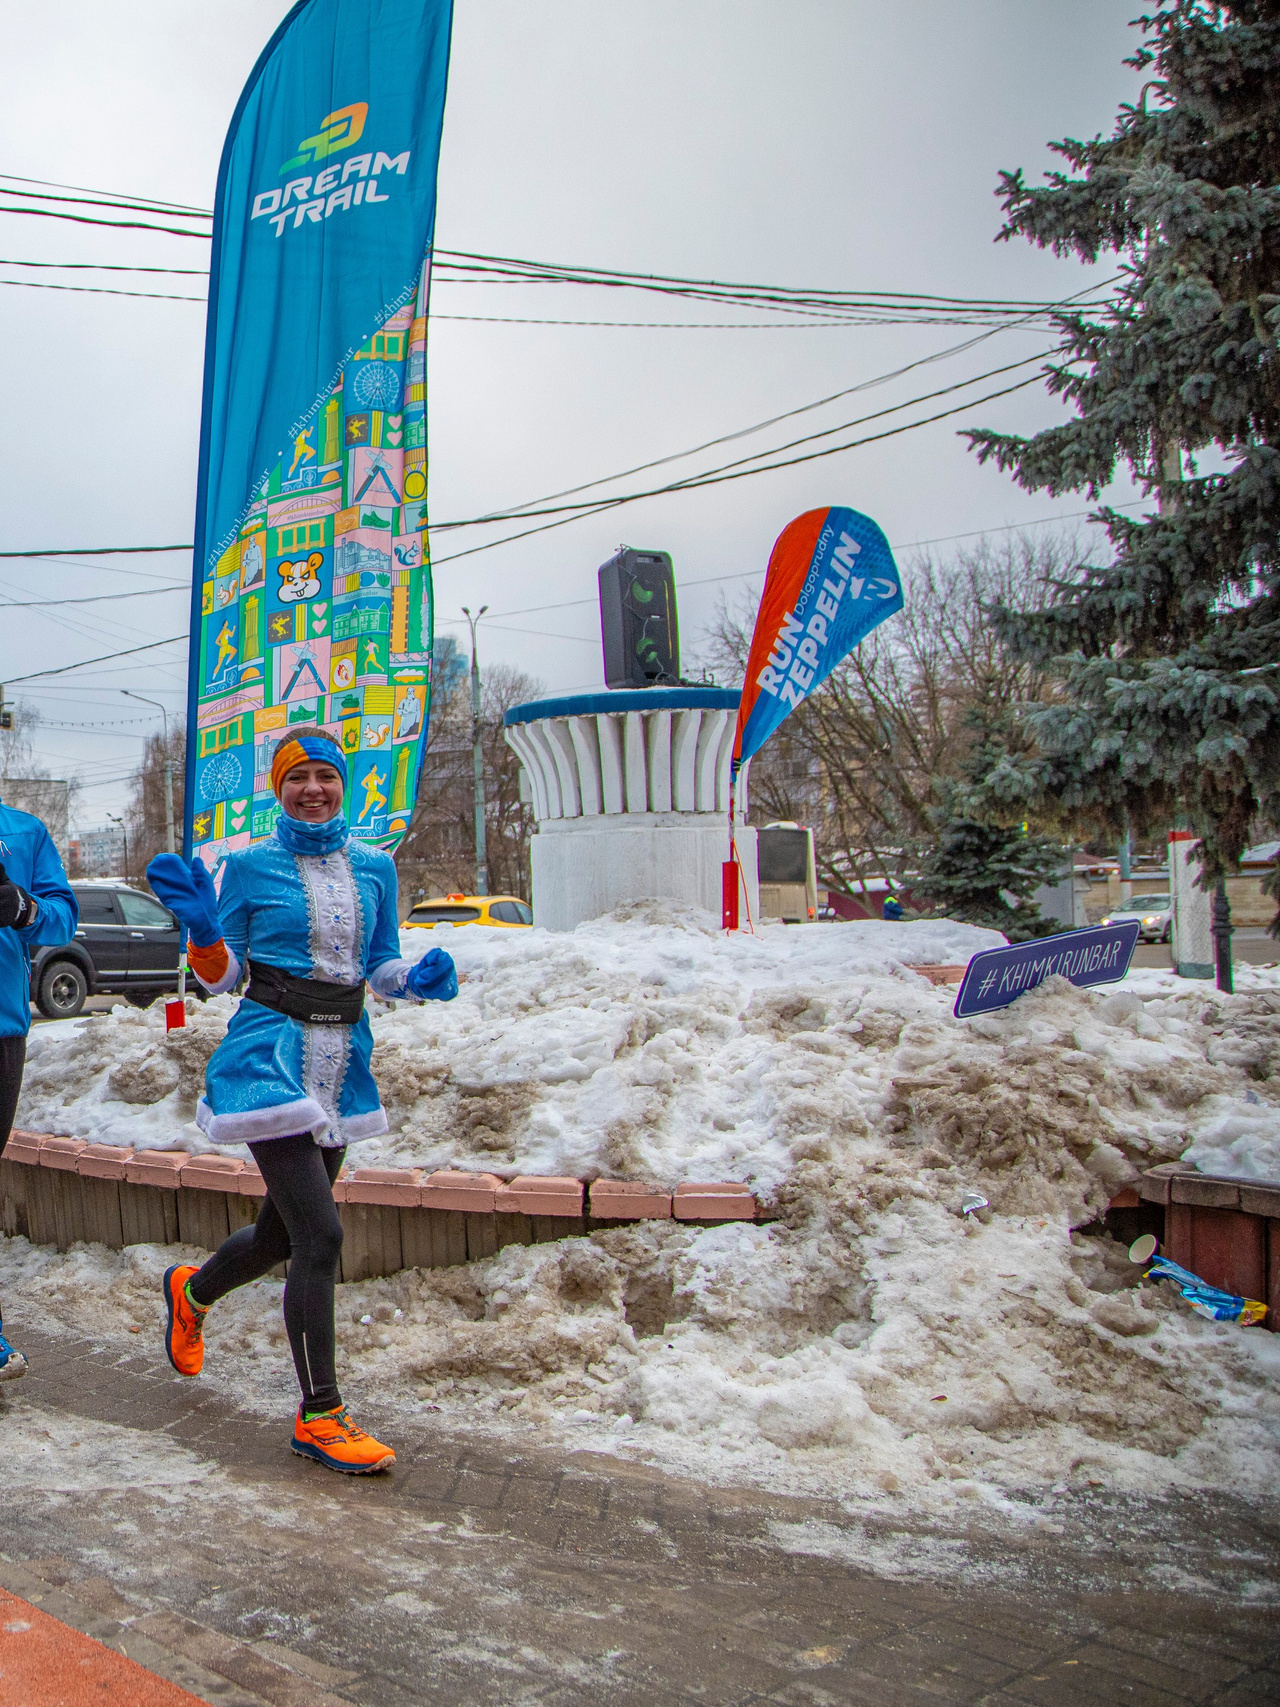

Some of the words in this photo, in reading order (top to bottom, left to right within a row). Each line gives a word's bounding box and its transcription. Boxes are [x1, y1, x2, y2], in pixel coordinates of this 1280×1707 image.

[251, 150, 411, 220] DREAM
[269, 179, 390, 238] TRAIL
[287, 346, 355, 439] #khimkirunbar
[756, 611, 805, 697] RUN
[794, 523, 835, 616] Dolgoprudny
[779, 530, 862, 711] ZEPPELIN
